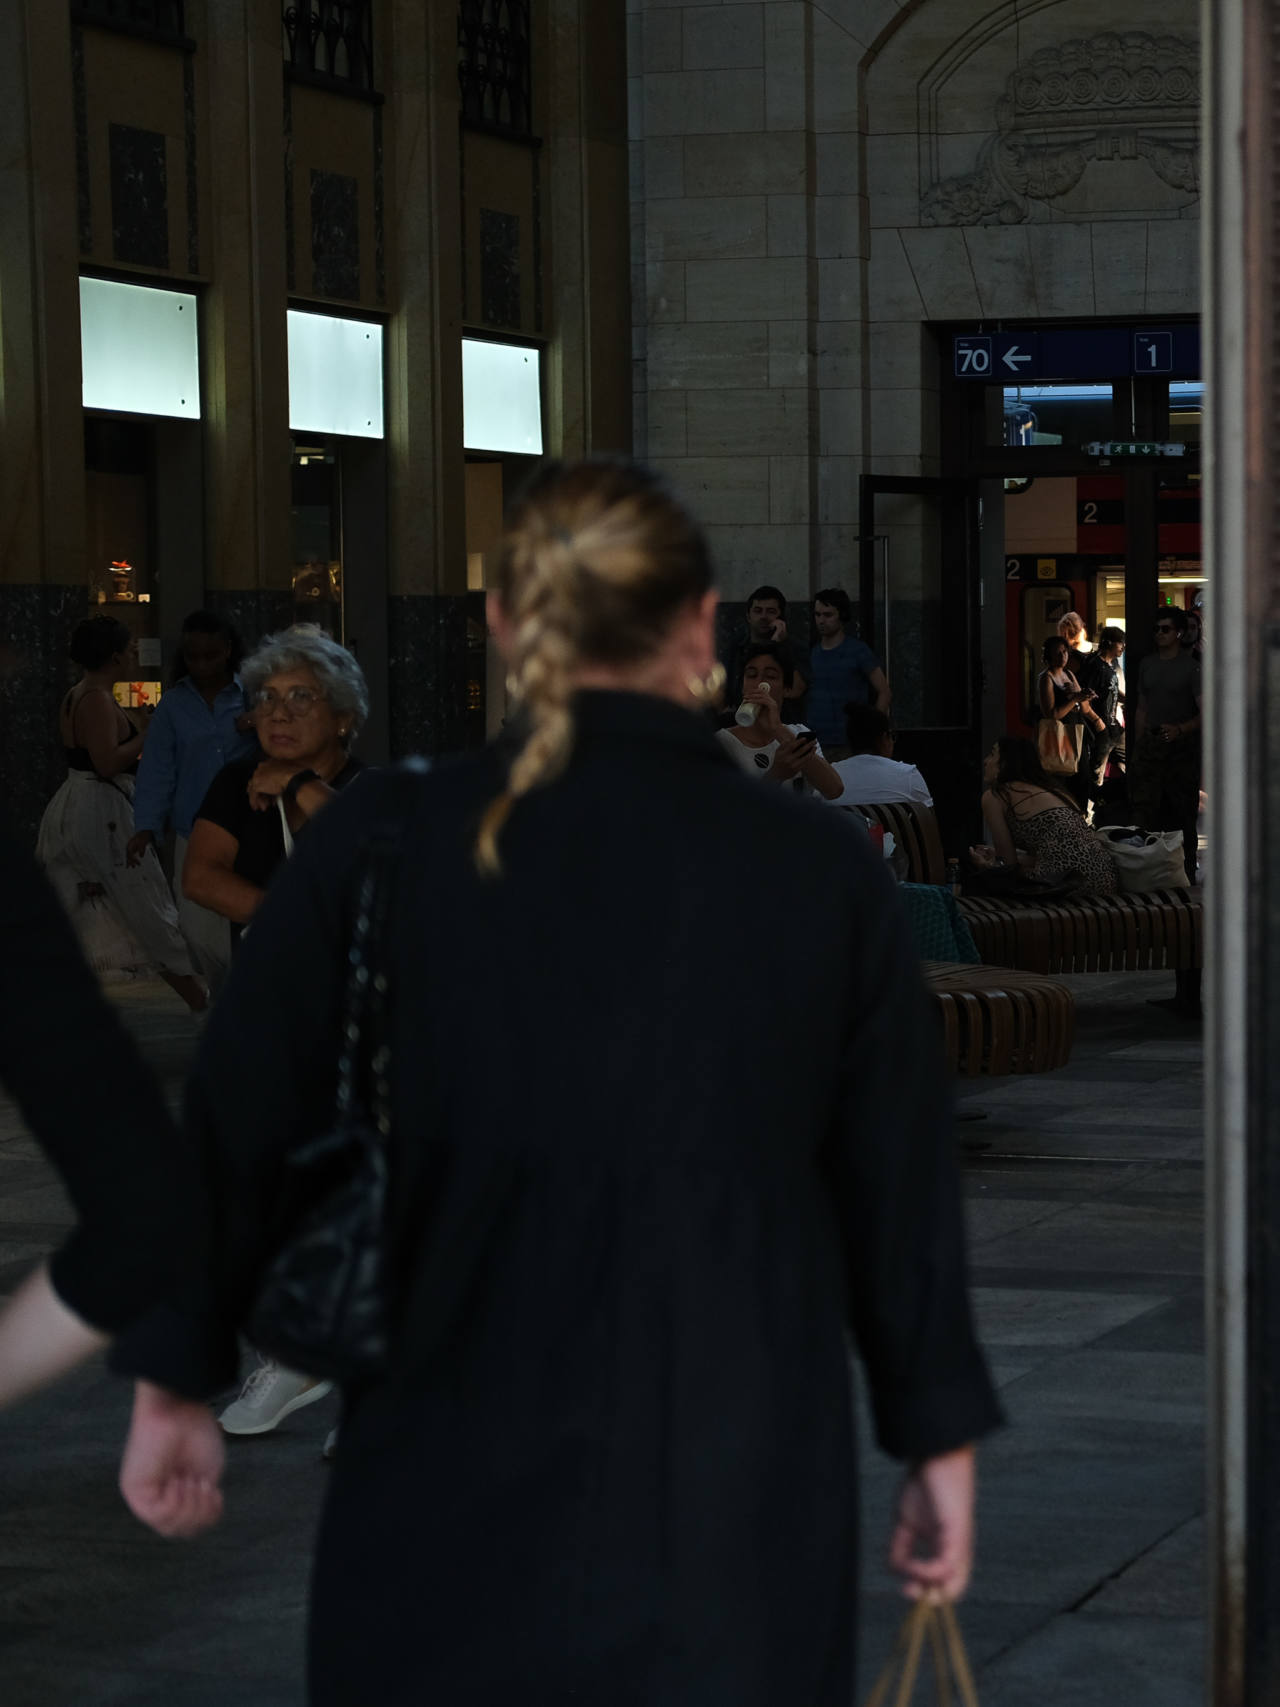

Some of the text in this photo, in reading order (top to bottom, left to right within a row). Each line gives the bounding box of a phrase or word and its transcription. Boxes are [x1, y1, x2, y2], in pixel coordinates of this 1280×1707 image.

[957, 348, 989, 373] 70
[1146, 343, 1158, 368] 1
[1083, 502, 1098, 524] 2
[1006, 559, 1021, 581] 2
